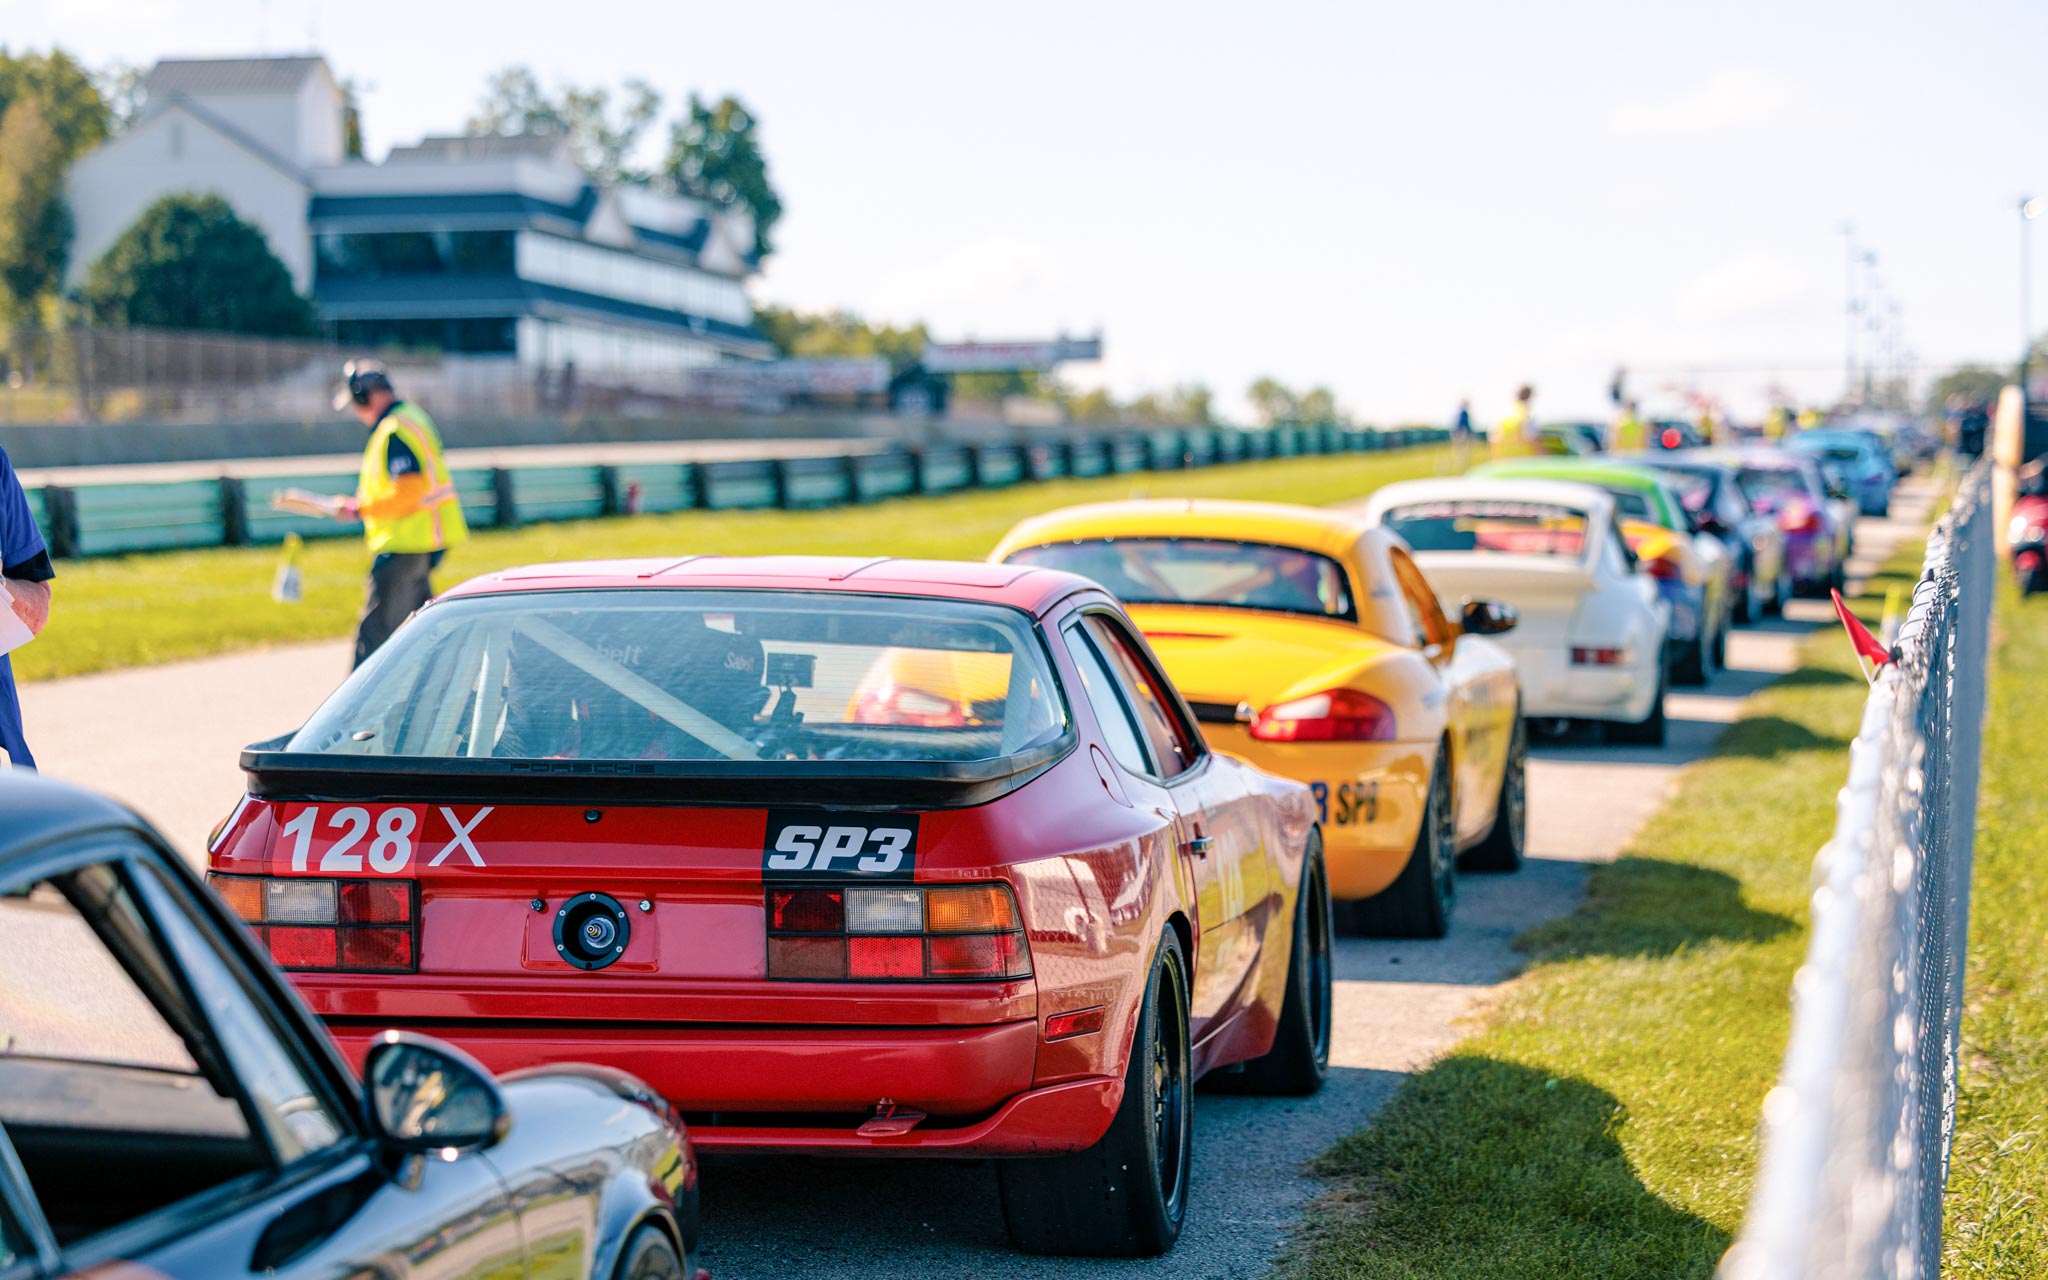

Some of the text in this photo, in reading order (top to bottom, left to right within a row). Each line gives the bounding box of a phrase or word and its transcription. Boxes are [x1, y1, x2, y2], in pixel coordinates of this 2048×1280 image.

[510, 762, 656, 774] PORSCHE
[282, 806, 495, 874] 128 X
[767, 825, 913, 873] SP3
